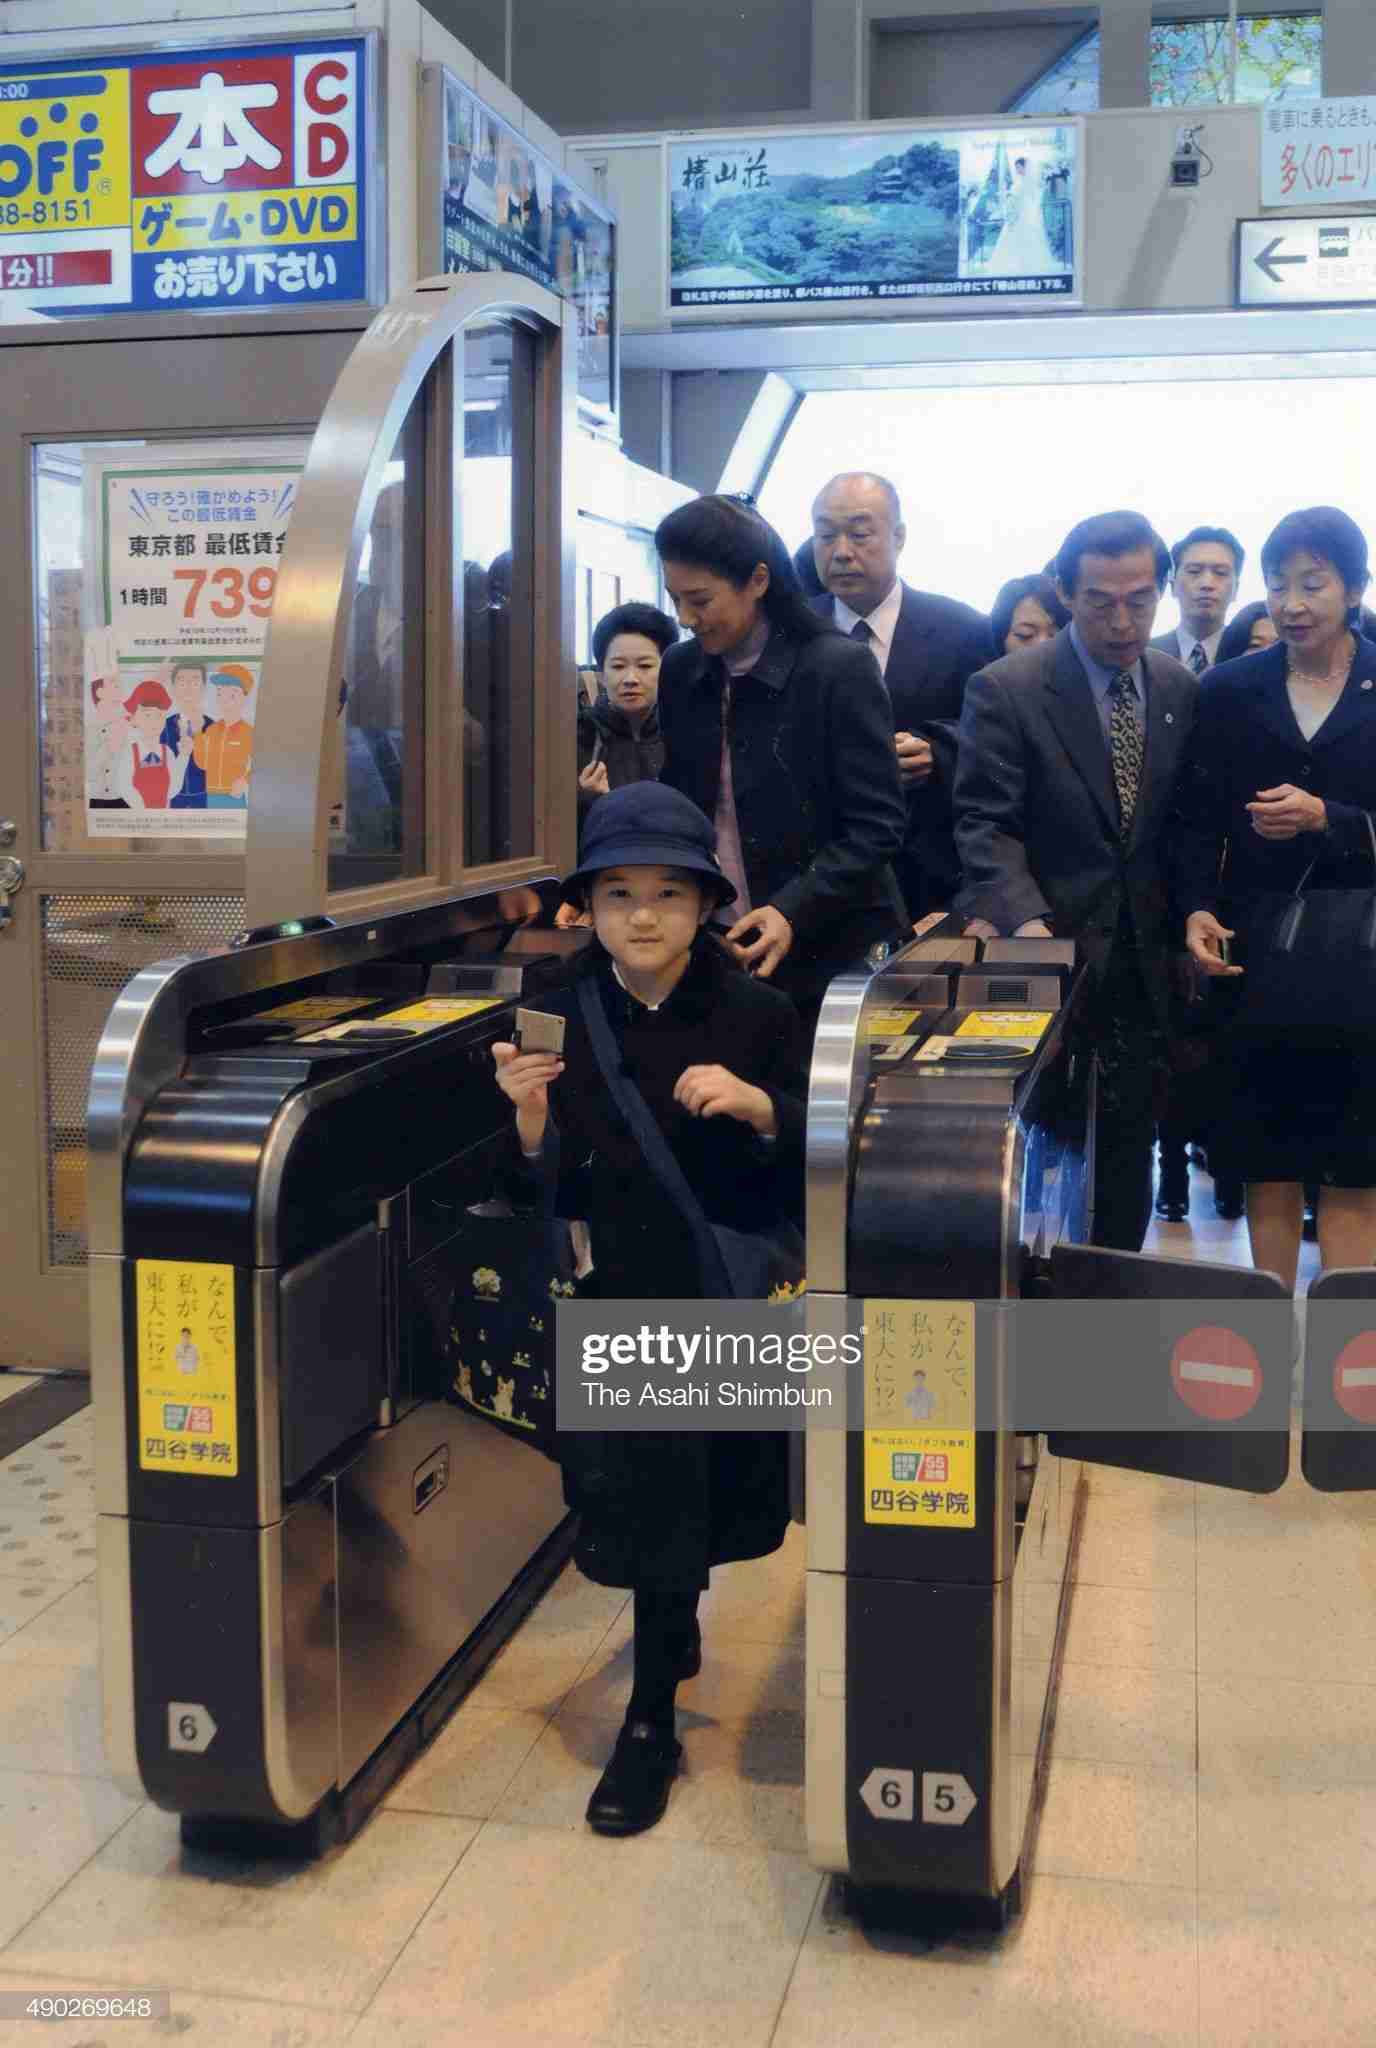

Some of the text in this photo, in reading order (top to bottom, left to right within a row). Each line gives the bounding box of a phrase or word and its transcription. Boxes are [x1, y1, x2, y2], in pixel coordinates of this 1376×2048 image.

[0, 83, 29, 99] :00
[144, 72, 282, 184] 本
[1280, 139, 1376, 194] 多くのエリ
[0, 198, 93, 225] 8-8151
[154, 251, 338, 299] お売り下さい
[167, 506, 257, 523] この最低賃金
[128, 533, 196, 558] 東京都
[120, 566, 278, 619] 1時間 739
[911, 1311, 935, 1360] 私が
[145, 1438, 233, 1465] 四谷学院
[871, 1488, 970, 1515] 四谷学院
[179, 1714, 198, 1741] 6
[880, 1780, 955, 1813] 6 5
